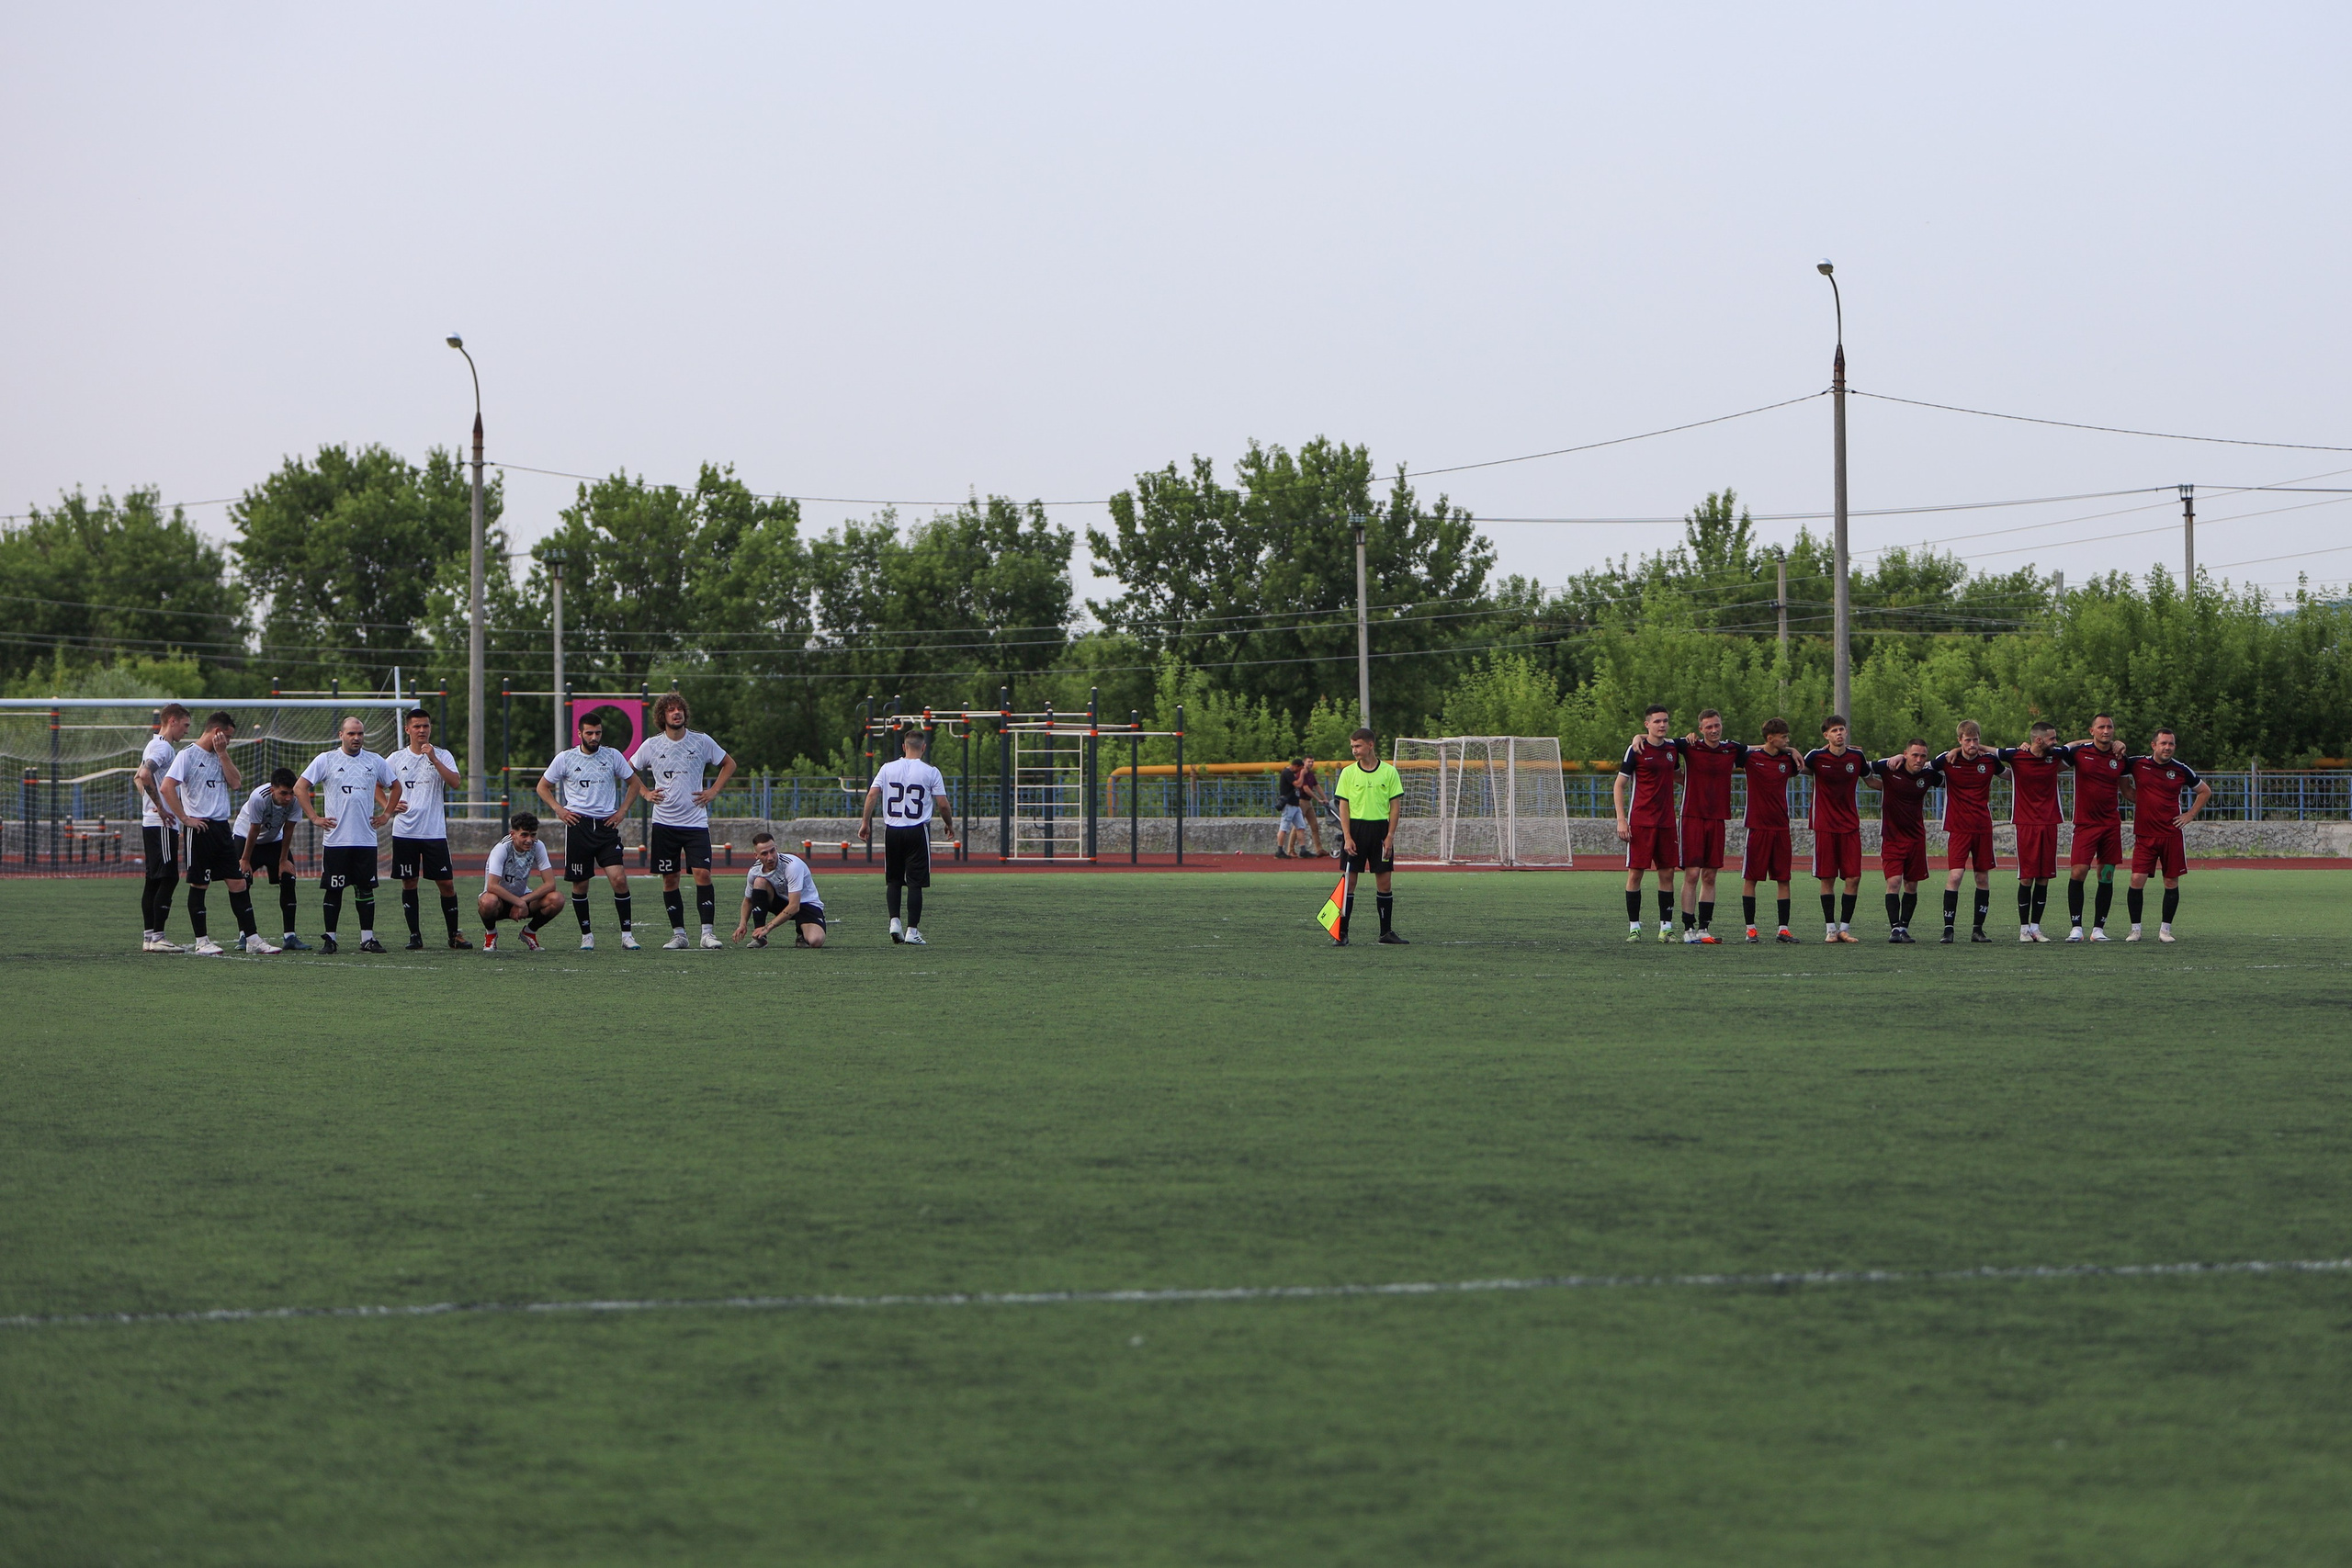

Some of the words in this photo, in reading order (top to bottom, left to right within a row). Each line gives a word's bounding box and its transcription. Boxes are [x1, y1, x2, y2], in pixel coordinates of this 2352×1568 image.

[887, 782, 925, 819] 23
[400, 863, 413, 876] 14
[571, 863, 582, 875] 44
[659, 859, 673, 872] 22
[204, 868, 211, 882] 3
[331, 874, 345, 888] 63
